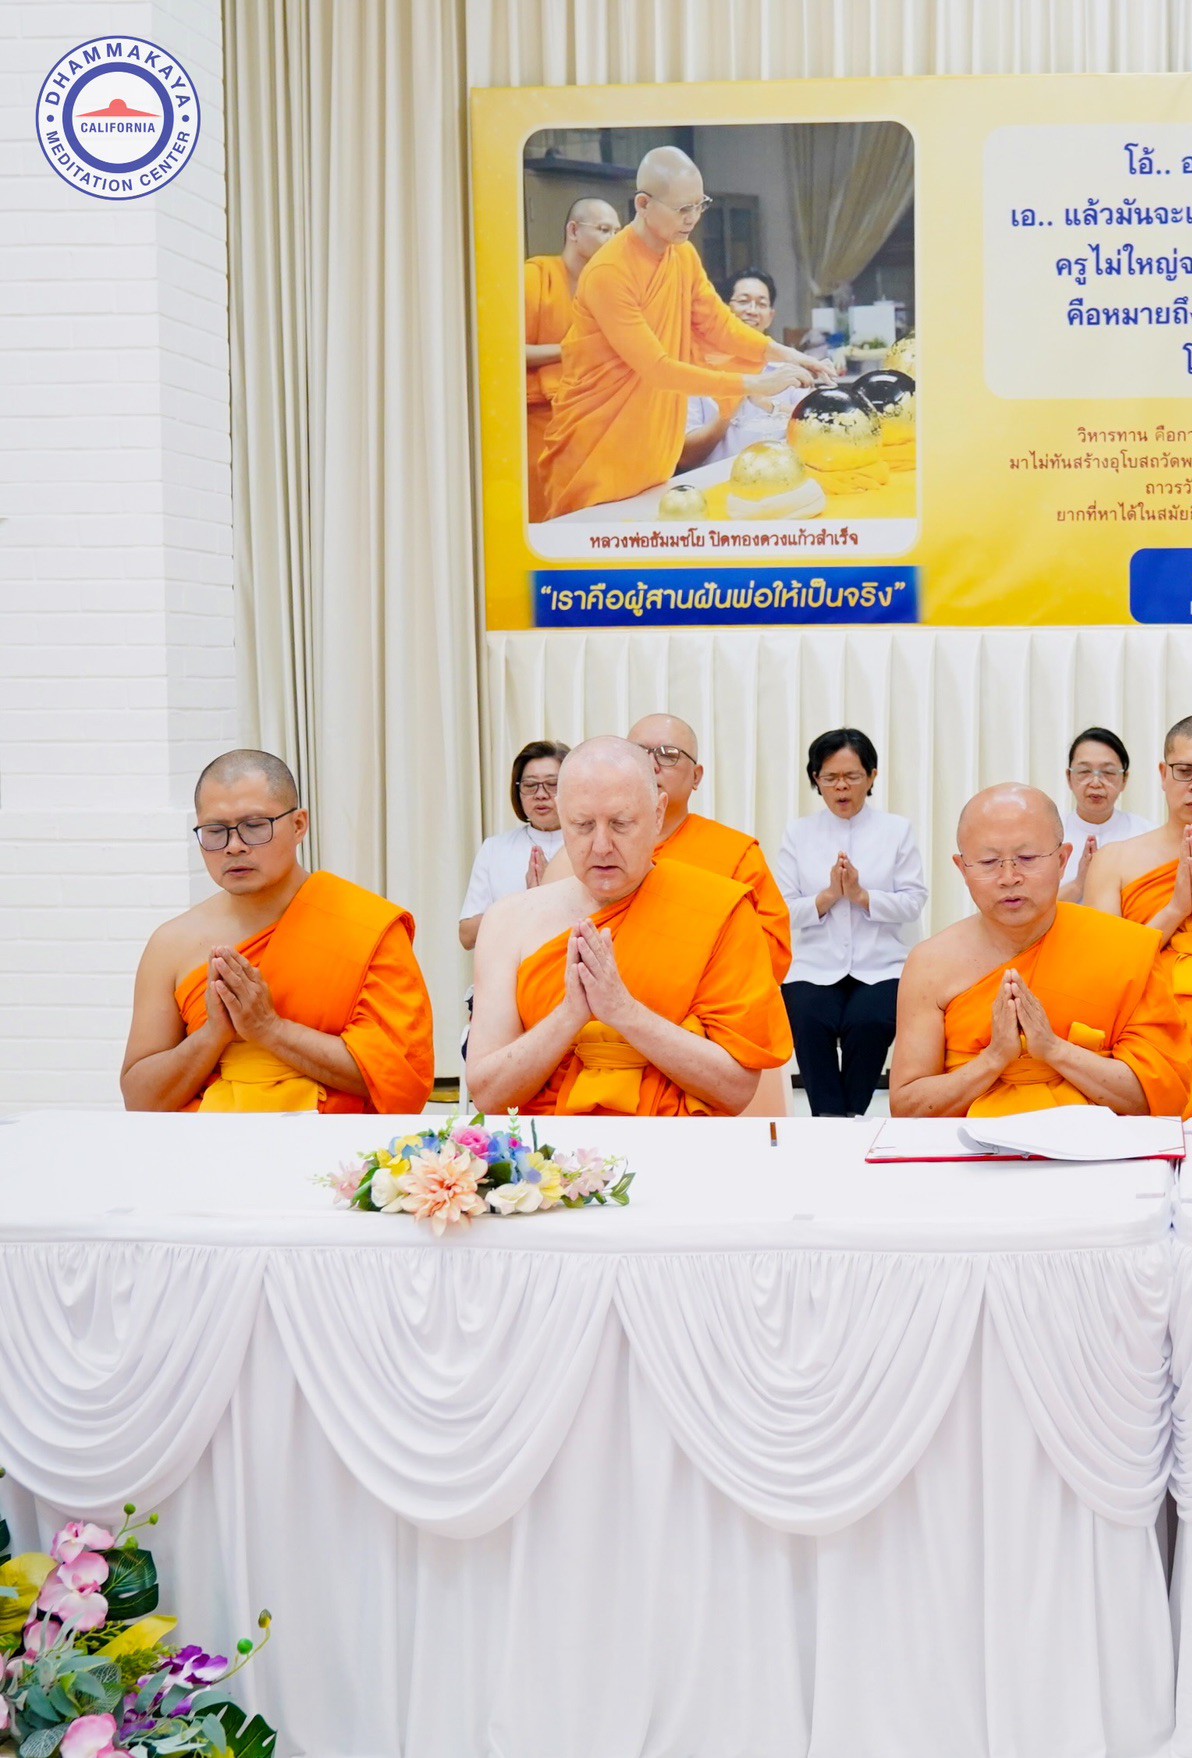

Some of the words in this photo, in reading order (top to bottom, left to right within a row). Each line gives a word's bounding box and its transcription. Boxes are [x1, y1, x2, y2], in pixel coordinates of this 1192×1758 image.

[1124, 142, 1170, 175] โอ้..
[1011, 208, 1053, 227] เอ..
[1077, 426, 1148, 442] วิหารทาน
[589, 527, 705, 548] หลวงพ่อธัมมชโย
